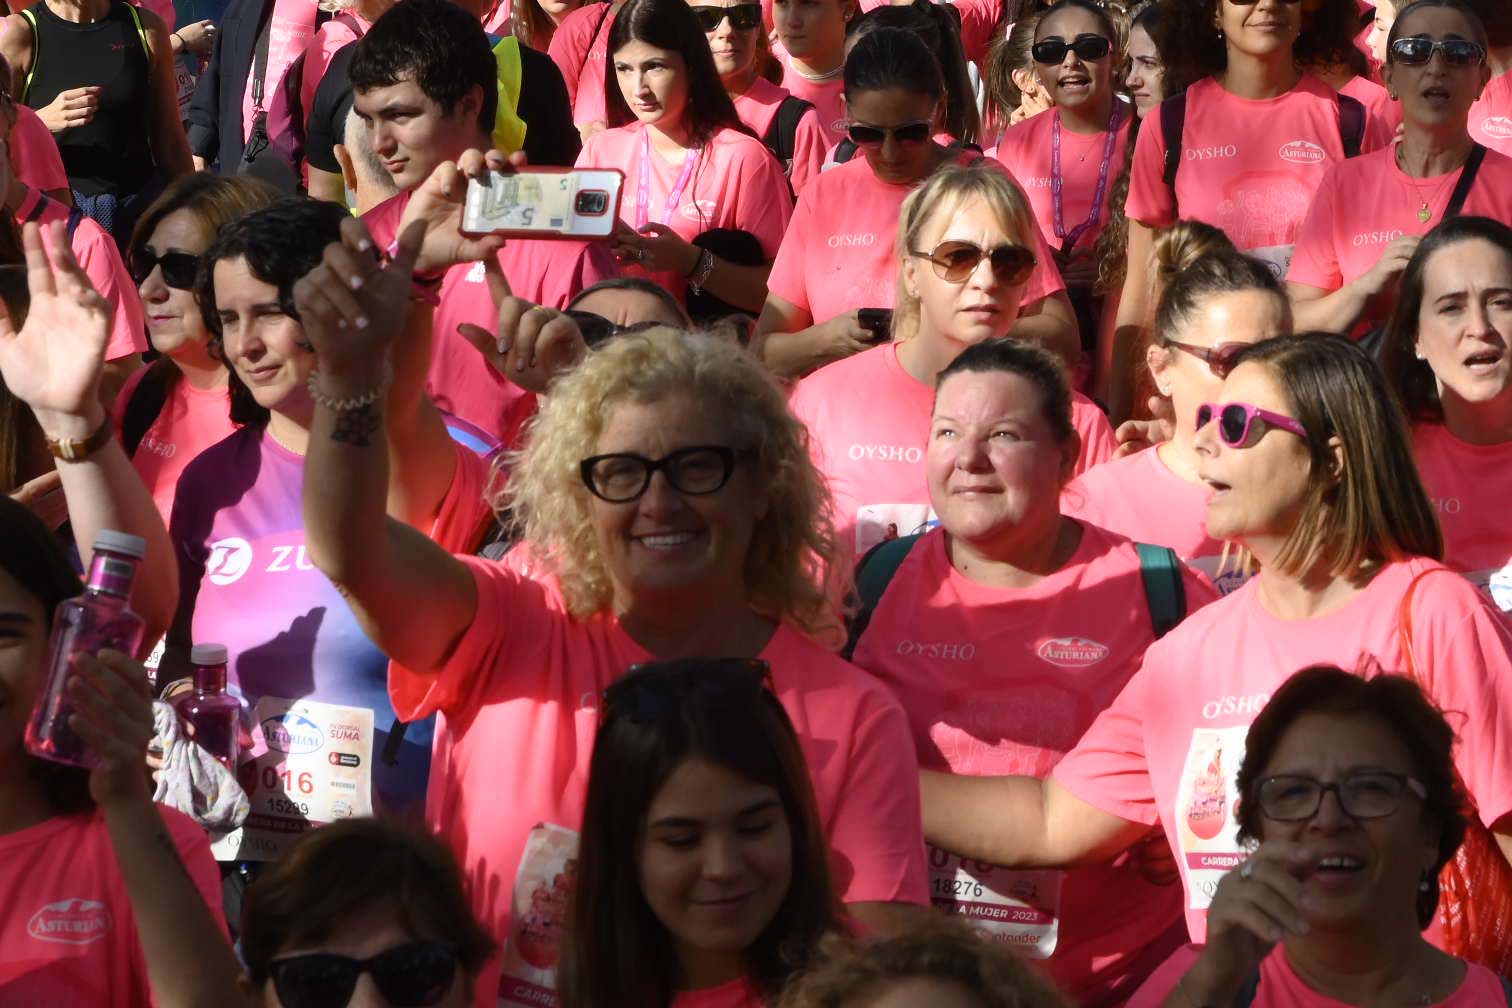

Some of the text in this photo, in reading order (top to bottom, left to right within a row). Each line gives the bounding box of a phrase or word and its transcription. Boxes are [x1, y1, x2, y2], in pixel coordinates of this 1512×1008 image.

[1186, 144, 1237, 161] OYSHO
[828, 232, 874, 248] OYSHO
[1353, 229, 1403, 247] OYSHO
[847, 443, 921, 463] OYSHO
[898, 639, 975, 660] OYSHO
[330, 731, 360, 741] SUMA
[262, 766, 314, 794] 016
[1201, 856, 1239, 867] CARRERA
[933, 878, 983, 897] 18276
[969, 906, 1008, 918] MUJER
[1012, 911, 1038, 920] 2023
[513, 985, 558, 1007] CARRE
